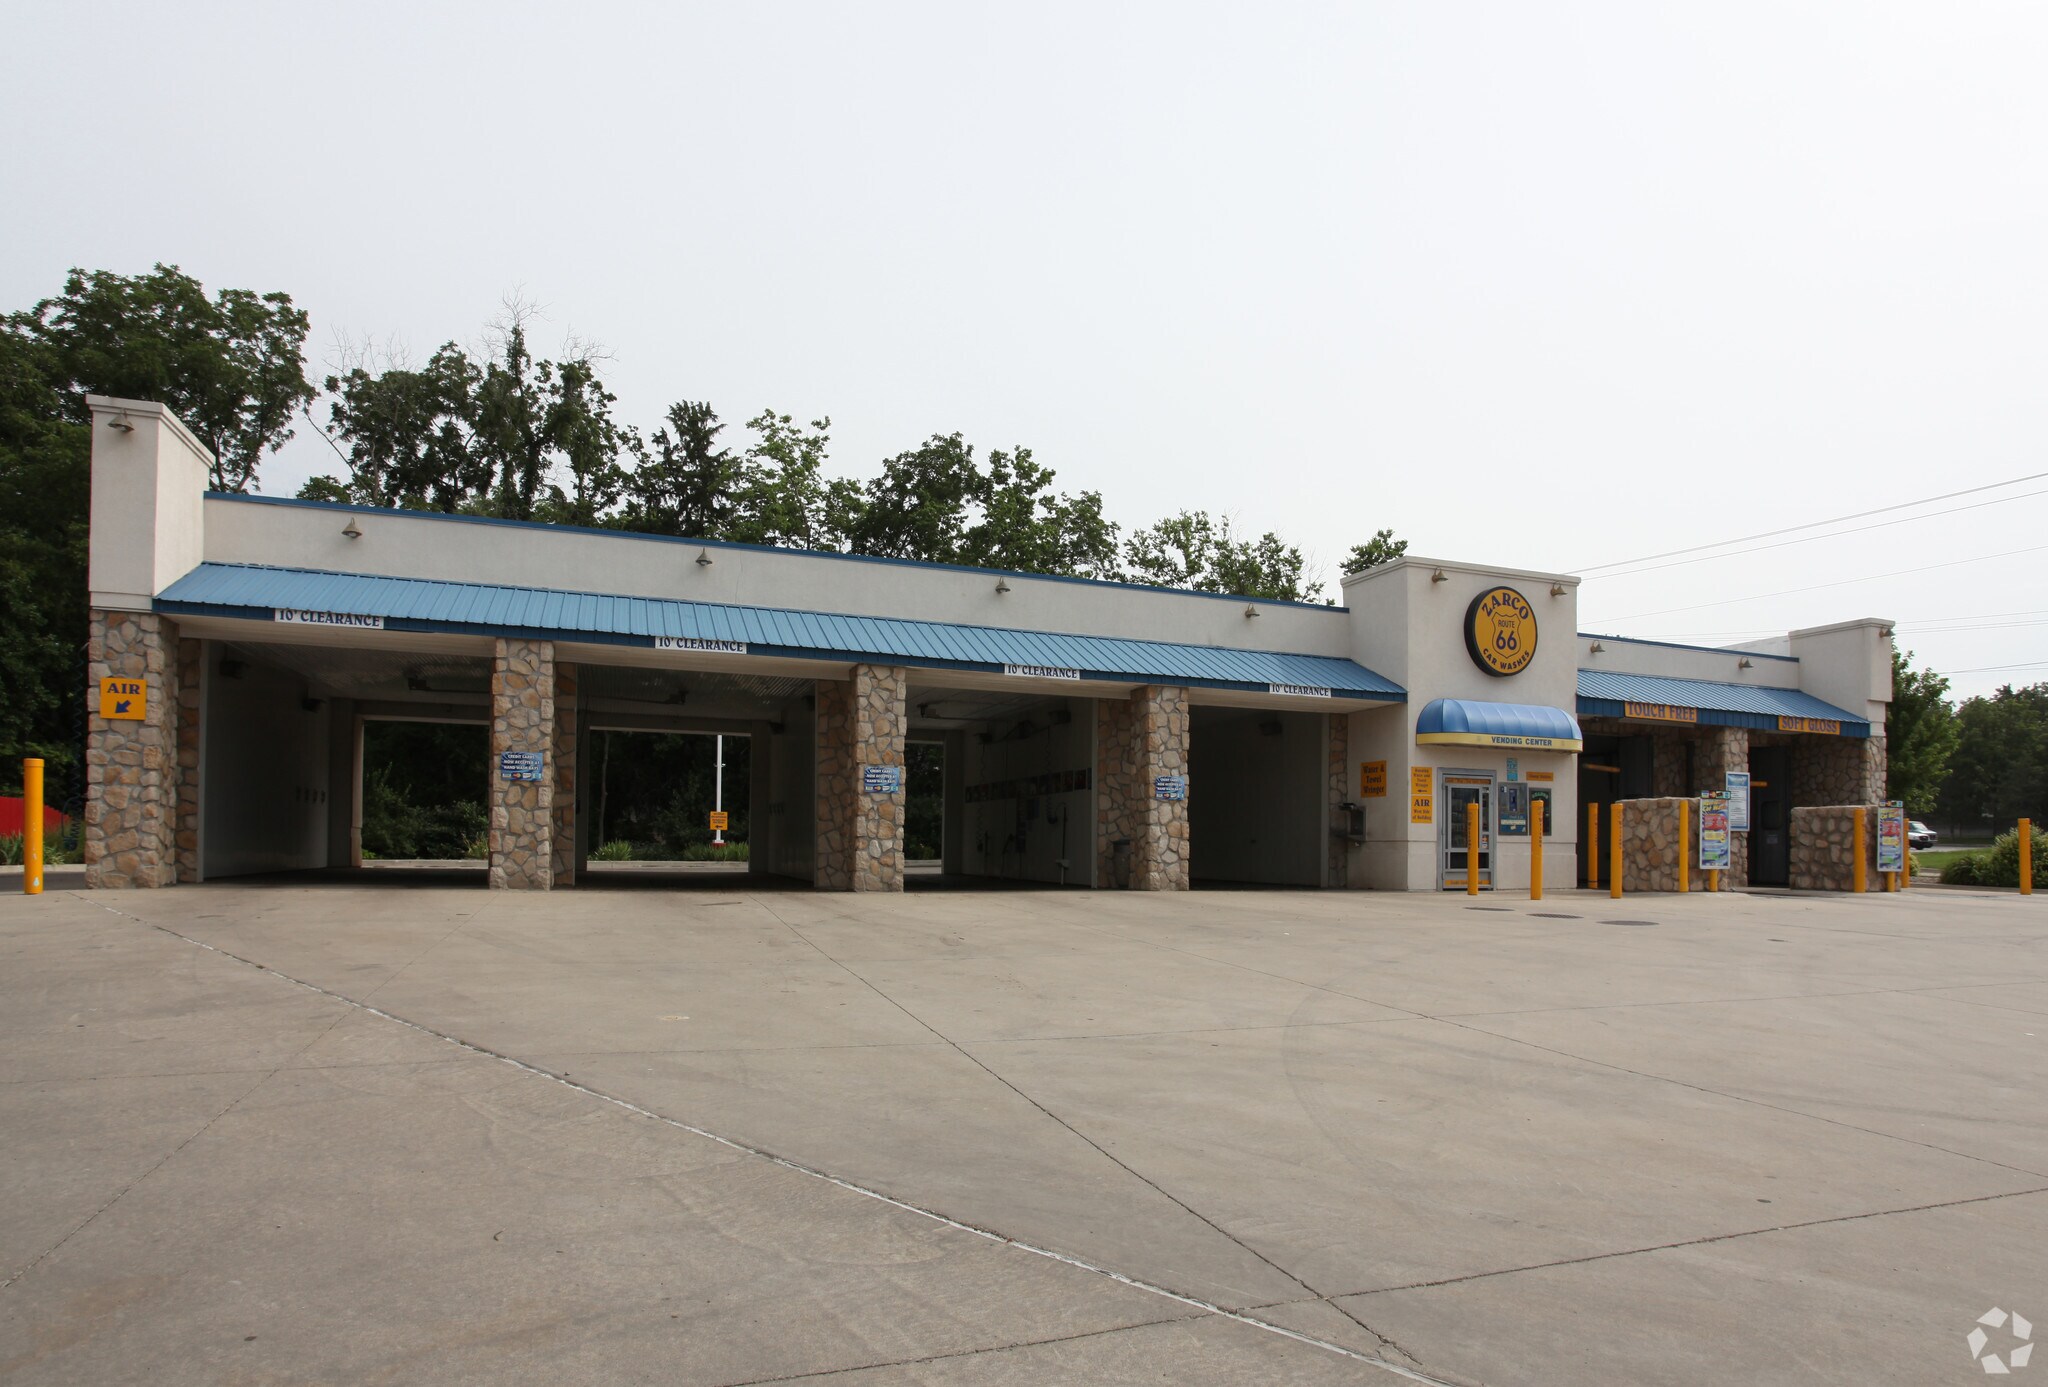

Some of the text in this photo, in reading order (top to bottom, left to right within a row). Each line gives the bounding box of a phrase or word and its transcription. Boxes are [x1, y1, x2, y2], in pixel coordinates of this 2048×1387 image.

[1481, 592, 1529, 619] ZARCO
[300, 611, 380, 627] CLEARANCE
[1498, 619, 1515, 629] ROUTE
[676, 638, 743, 652] CLEARANCE
[1495, 629, 1518, 651] 66
[1483, 648, 1530, 670] CAR WASHES
[1022, 665, 1077, 679] CLEARANCE
[107, 683, 141, 695] AIR
[1283, 685, 1329, 697] CLEARANCE
[1627, 702, 1695, 721] TOUCH FREE
[1782, 716, 1838, 733] SOFT GLOSS
[1491, 736, 1553, 747] VENDING CENTER
[1366, 776, 1382, 784] Towel
[1363, 786, 1384, 795] Wringer
[1414, 799, 1430, 807] AIR
